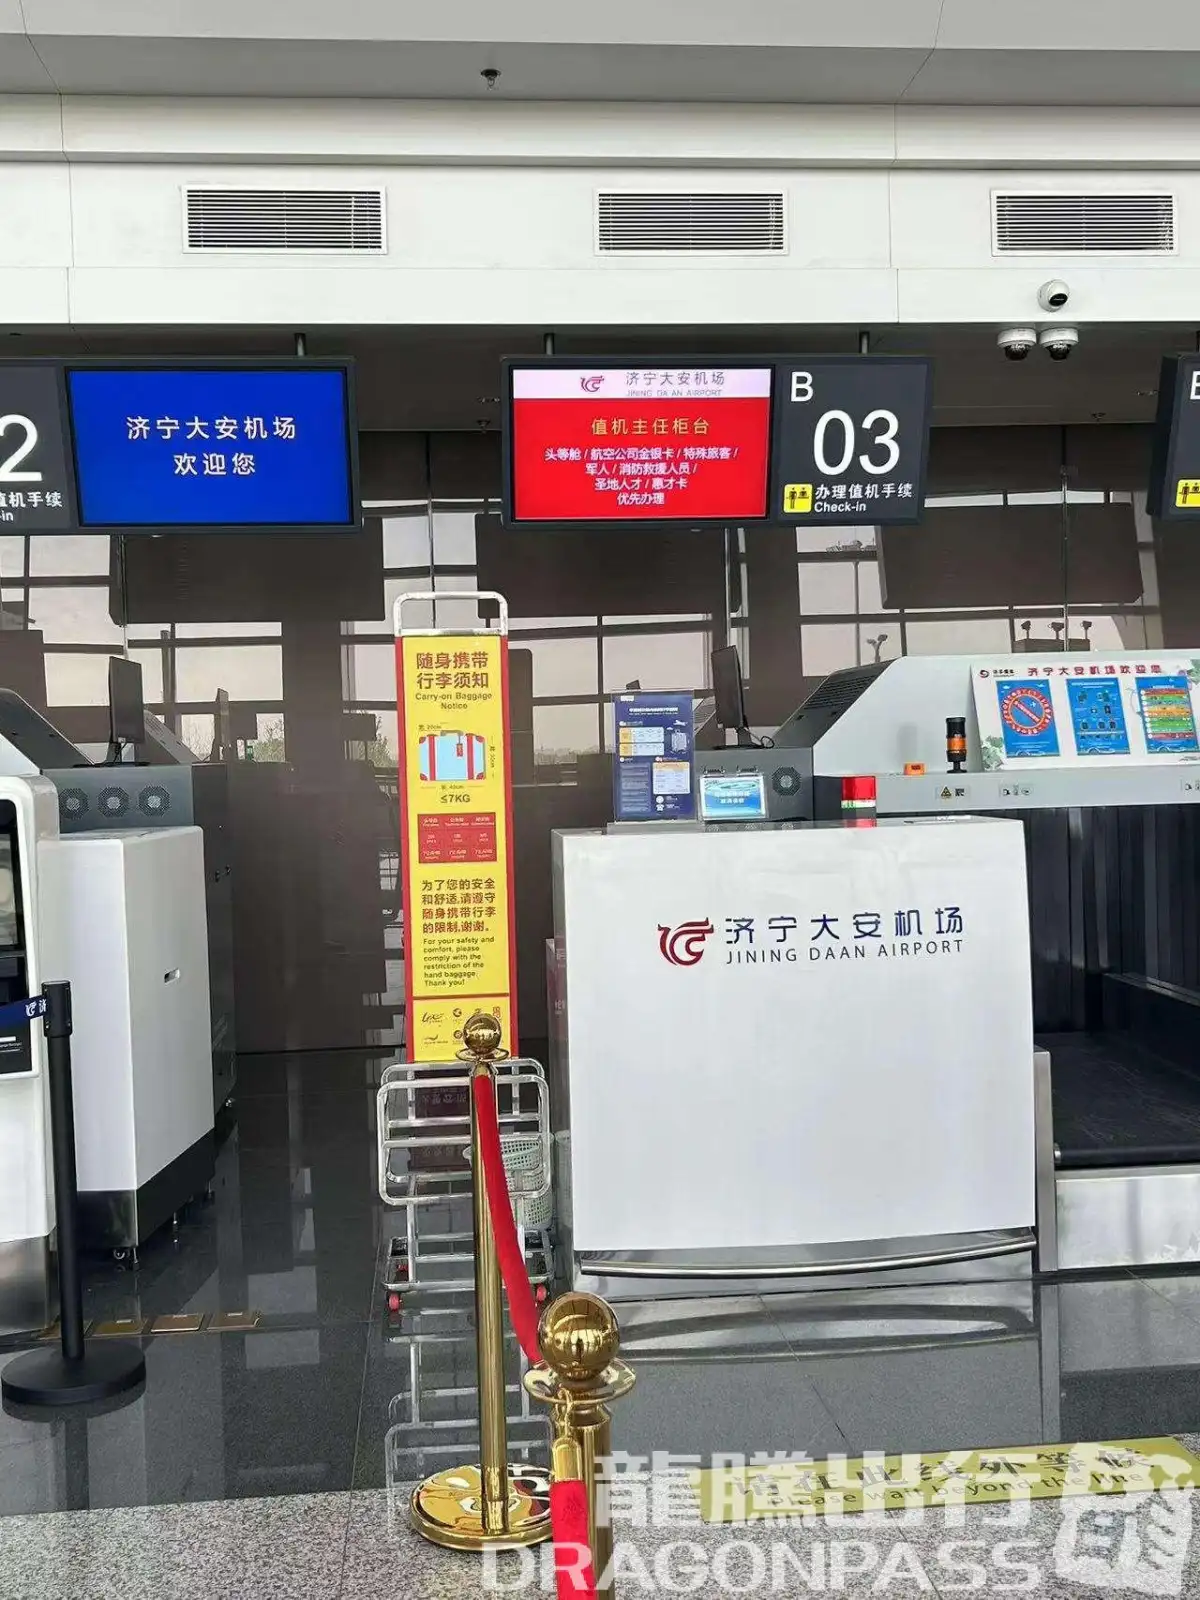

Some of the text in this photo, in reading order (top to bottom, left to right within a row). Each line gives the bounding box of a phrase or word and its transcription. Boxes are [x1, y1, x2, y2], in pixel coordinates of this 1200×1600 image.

[626, 371, 725, 386] 济宁大安机场
[627, 389, 652, 397] JINING
[686, 389, 722, 397] AIRPORT
[791, 371, 814, 402] B
[126, 416, 296, 440] 济宁大安机场
[591, 417, 709, 436] 值机主任柜台
[813, 409, 900, 476] 03
[174, 452, 256, 476] 欢迎您
[617, 492, 665, 505] 优先办理
[815, 483, 913, 499] 办理值机手续
[814, 502, 867, 513] Check-in
[416, 651, 488, 669] 随身携带
[416, 672, 489, 689] 行李须知
[415, 692, 492, 701] Carry-on Baggage
[422, 877, 495, 891] 为了您的安全
[422, 906, 496, 919] 随身携带行李
[725, 906, 963, 945] 济宁大安机场
[437, 938, 454, 946] your
[456, 936, 479, 944] safety
[456, 945, 480, 954] please
[726, 939, 964, 965] JINING DAAN AIRPORT
[449, 979, 465, 987] you!
